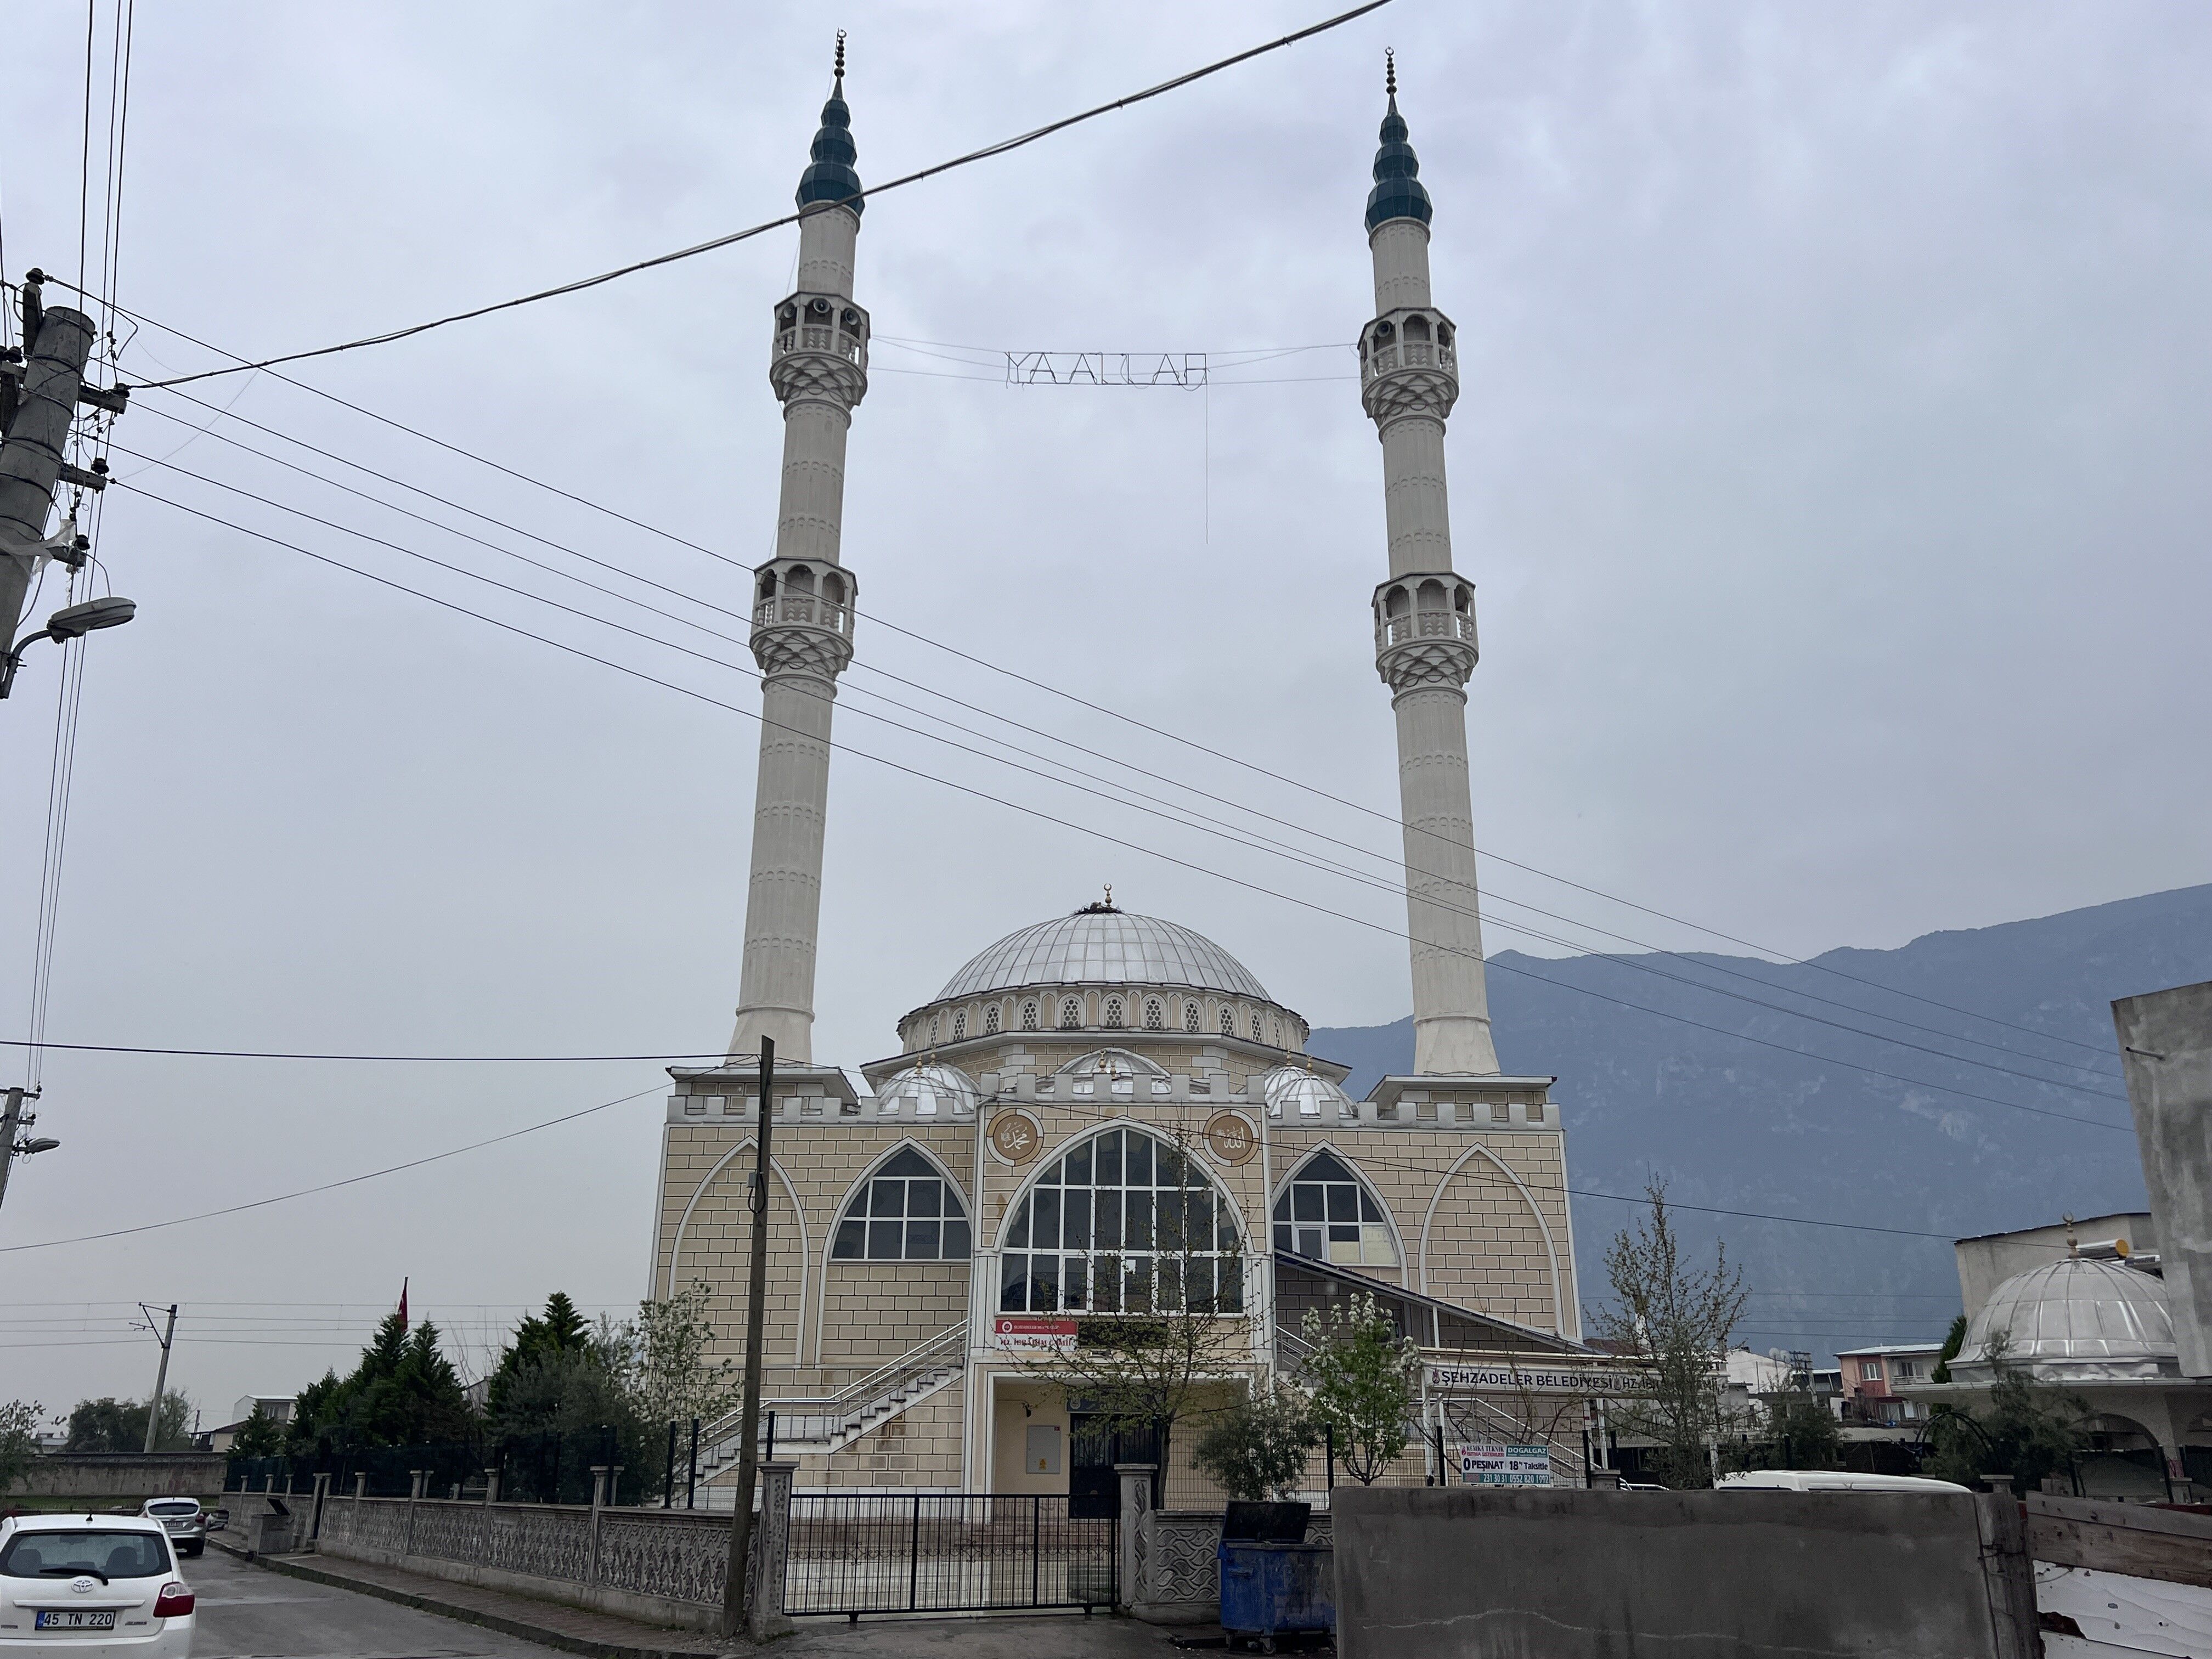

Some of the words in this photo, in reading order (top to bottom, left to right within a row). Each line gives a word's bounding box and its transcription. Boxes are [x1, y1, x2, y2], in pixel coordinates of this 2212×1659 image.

[1442, 1371, 1533, 1386] ŞEHZADELER
[1537, 1374, 1613, 1389] BELEDİYESİ
[1523, 1462, 1548, 1470] Taksitle
[1483, 1474, 1493, 1483] 231
[1494, 1474, 1500, 1483] 30
[1501, 1474, 1508, 1483] 31
[1509, 1474, 1523, 1483] 0552
[1524, 1475, 1534, 1483] 820
[1536, 1475, 1549, 1484] 1992
[44, 1613, 60, 1626] 45
[68, 1613, 83, 1626] TN
[89, 1613, 112, 1626] 220
